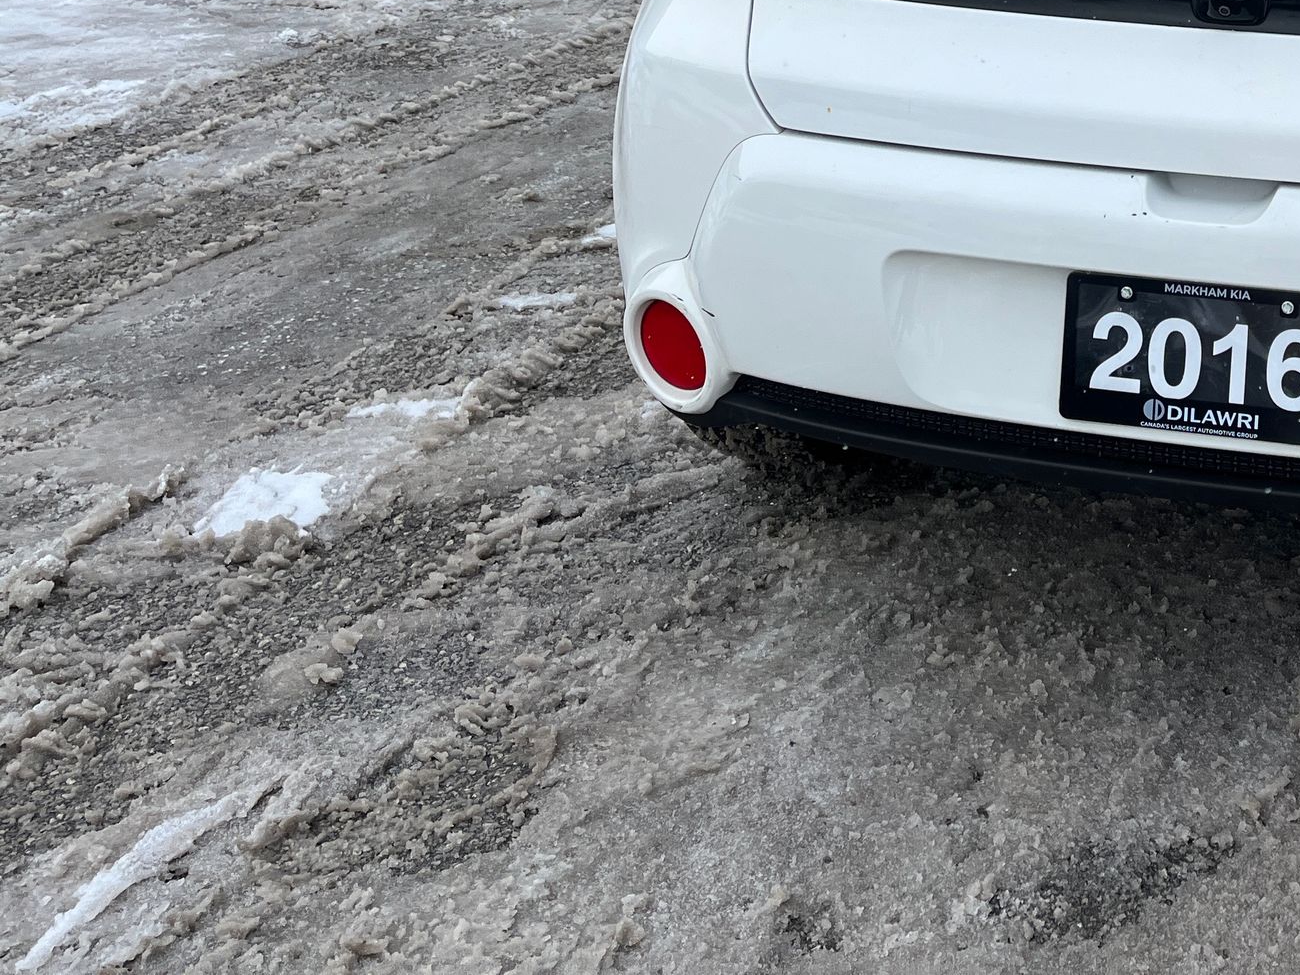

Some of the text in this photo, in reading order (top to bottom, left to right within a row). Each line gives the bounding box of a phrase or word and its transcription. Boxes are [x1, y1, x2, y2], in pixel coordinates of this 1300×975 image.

[1164, 283, 1251, 301] MARKHAM KIA
[1167, 404, 1259, 430] DILAWRI
[1140, 421, 1258, 439] CANADA'S LARGEST AUTOMOTIVE GROUP
